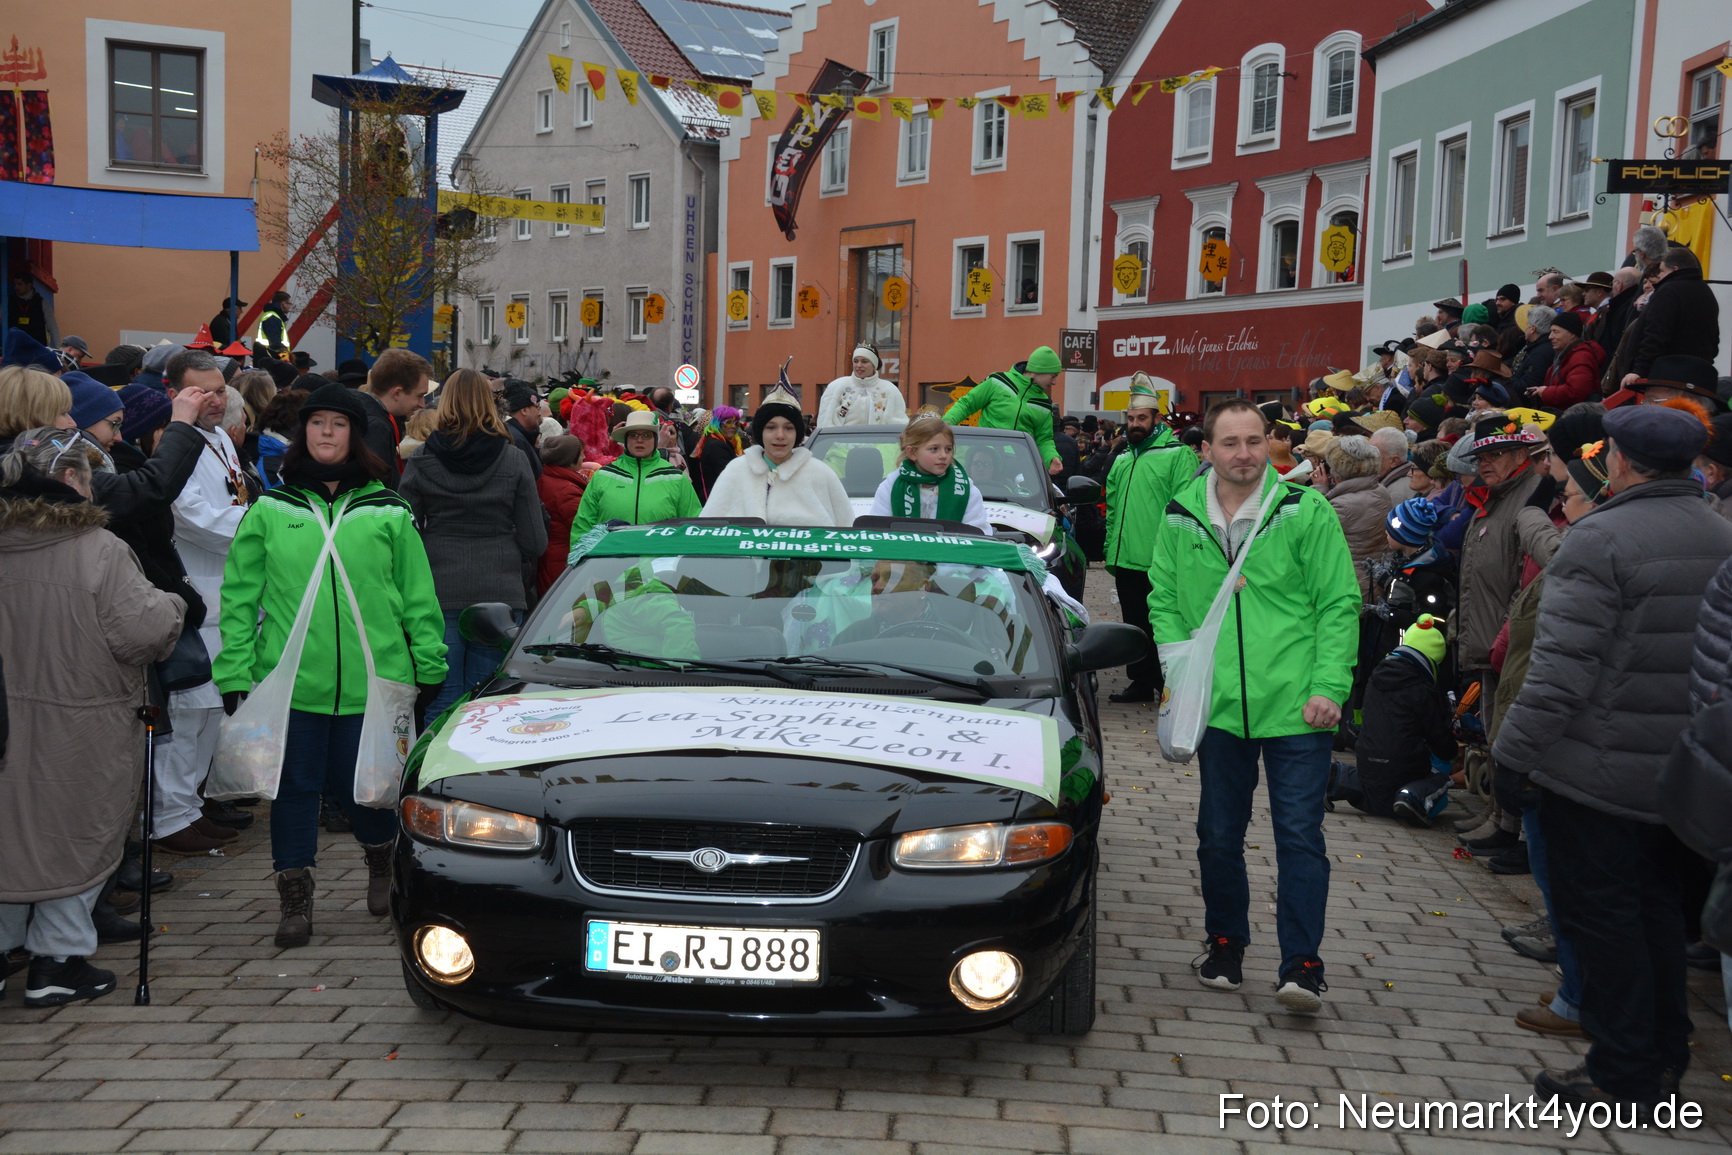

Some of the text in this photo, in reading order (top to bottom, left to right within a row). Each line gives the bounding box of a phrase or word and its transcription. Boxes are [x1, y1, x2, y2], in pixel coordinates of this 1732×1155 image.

[683, 196, 696, 364] UHREN SCHMUCK
[1064, 334, 1092, 349] CAFÉ
[1172, 330, 1198, 355] Mode
[1198, 337, 1223, 360] Genuss
[1226, 326, 1258, 351] Erlebnis
[881, 358, 900, 374] TZ
[645, 525, 974, 546] FG Grün-Weiß Zwiebelonia
[739, 540, 873, 553] Beilngries
[721, 696, 1019, 728] Kinderprinzenpaar
[541, 733, 570, 743] 2000
[603, 709, 990, 746] Lea-Sophie I. &
[690, 725, 1012, 769] Mike-Leon I.
[613, 930, 655, 966] EI
[625, 973, 653, 982] Autohaus
[705, 977, 735, 985] Beilngries
